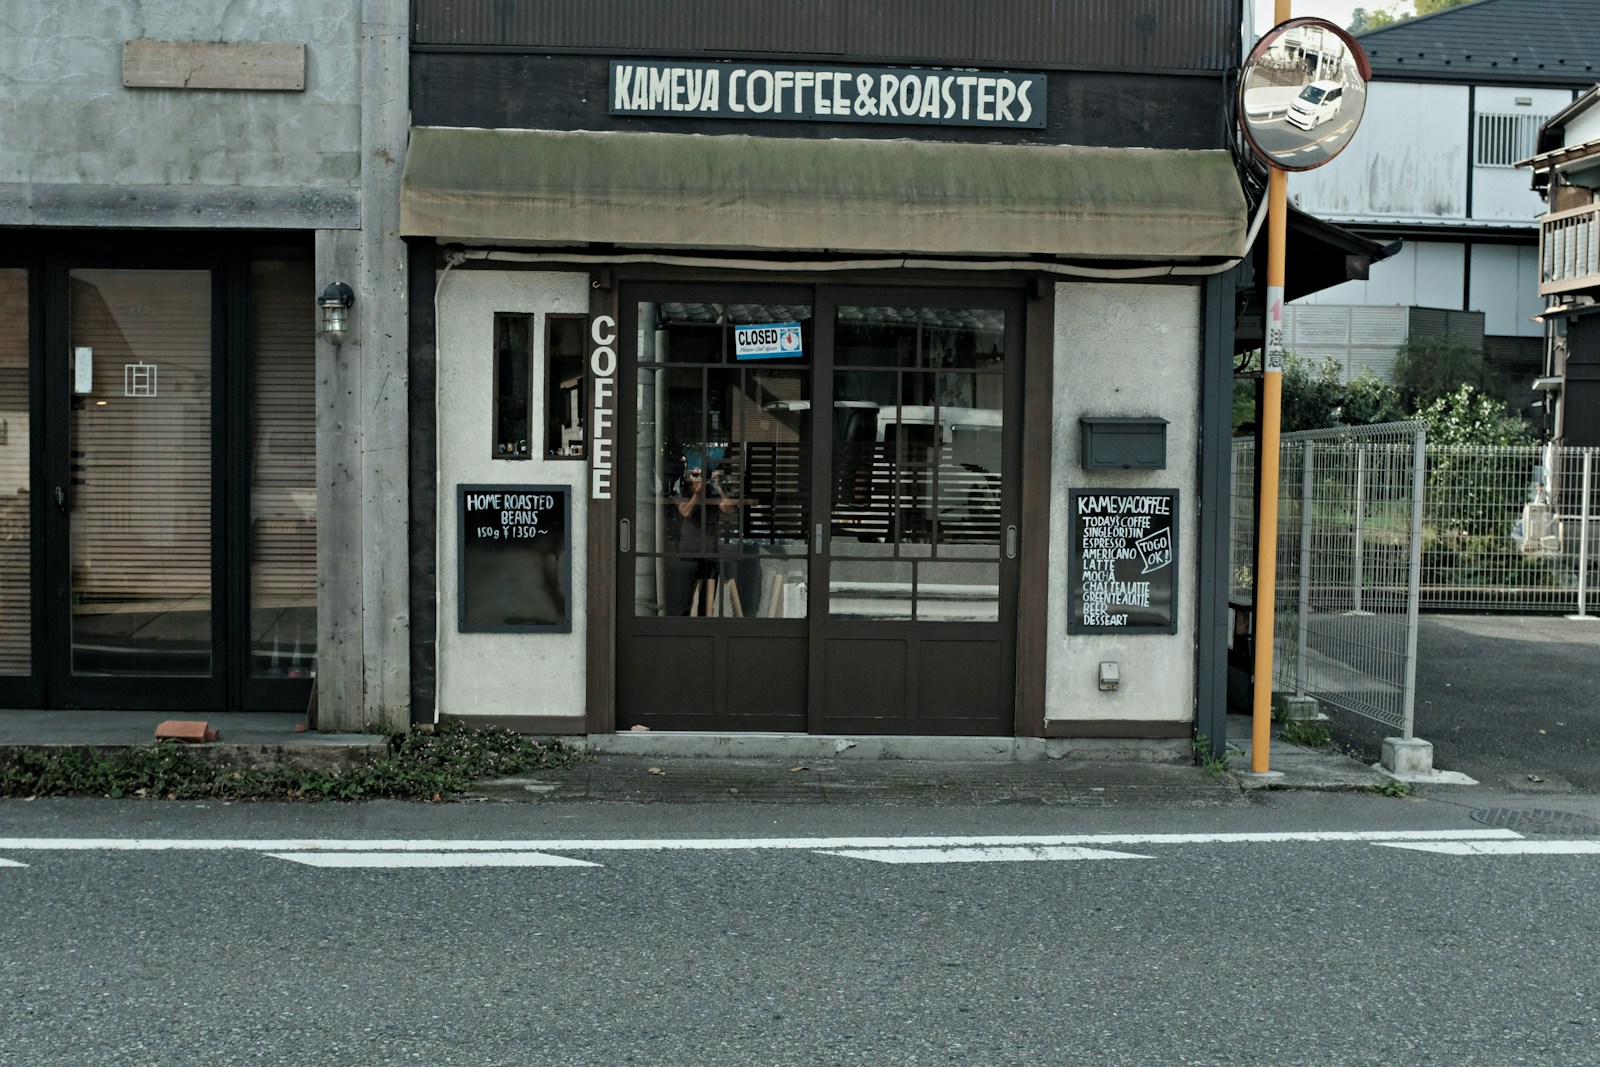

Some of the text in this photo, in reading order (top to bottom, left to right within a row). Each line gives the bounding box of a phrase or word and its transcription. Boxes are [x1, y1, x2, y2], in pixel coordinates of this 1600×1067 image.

[615, 65, 720, 112] KAMEYA
[738, 329, 778, 346] CLOSED
[1269, 328, 1283, 368] 注意
[591, 315, 617, 499] COFFEE
[467, 494, 554, 511] HOME ROASTED
[501, 511, 538, 525] BEANS
[1120, 516, 1151, 529] COFFEE
[477, 526, 499, 539] 150g
[1082, 538, 1126, 549] ESPRESSO
[1082, 548, 1137, 560] AMERICANO
[1147, 549, 1169, 565] OK!
[1083, 559, 1115, 571] LATTE
[1082, 570, 1115, 582] MOCHA
[1082, 582, 1150, 596] CHAI TEA LATTE
[1083, 603, 1108, 616] BEER
[1083, 614, 1128, 626] DESSEART
